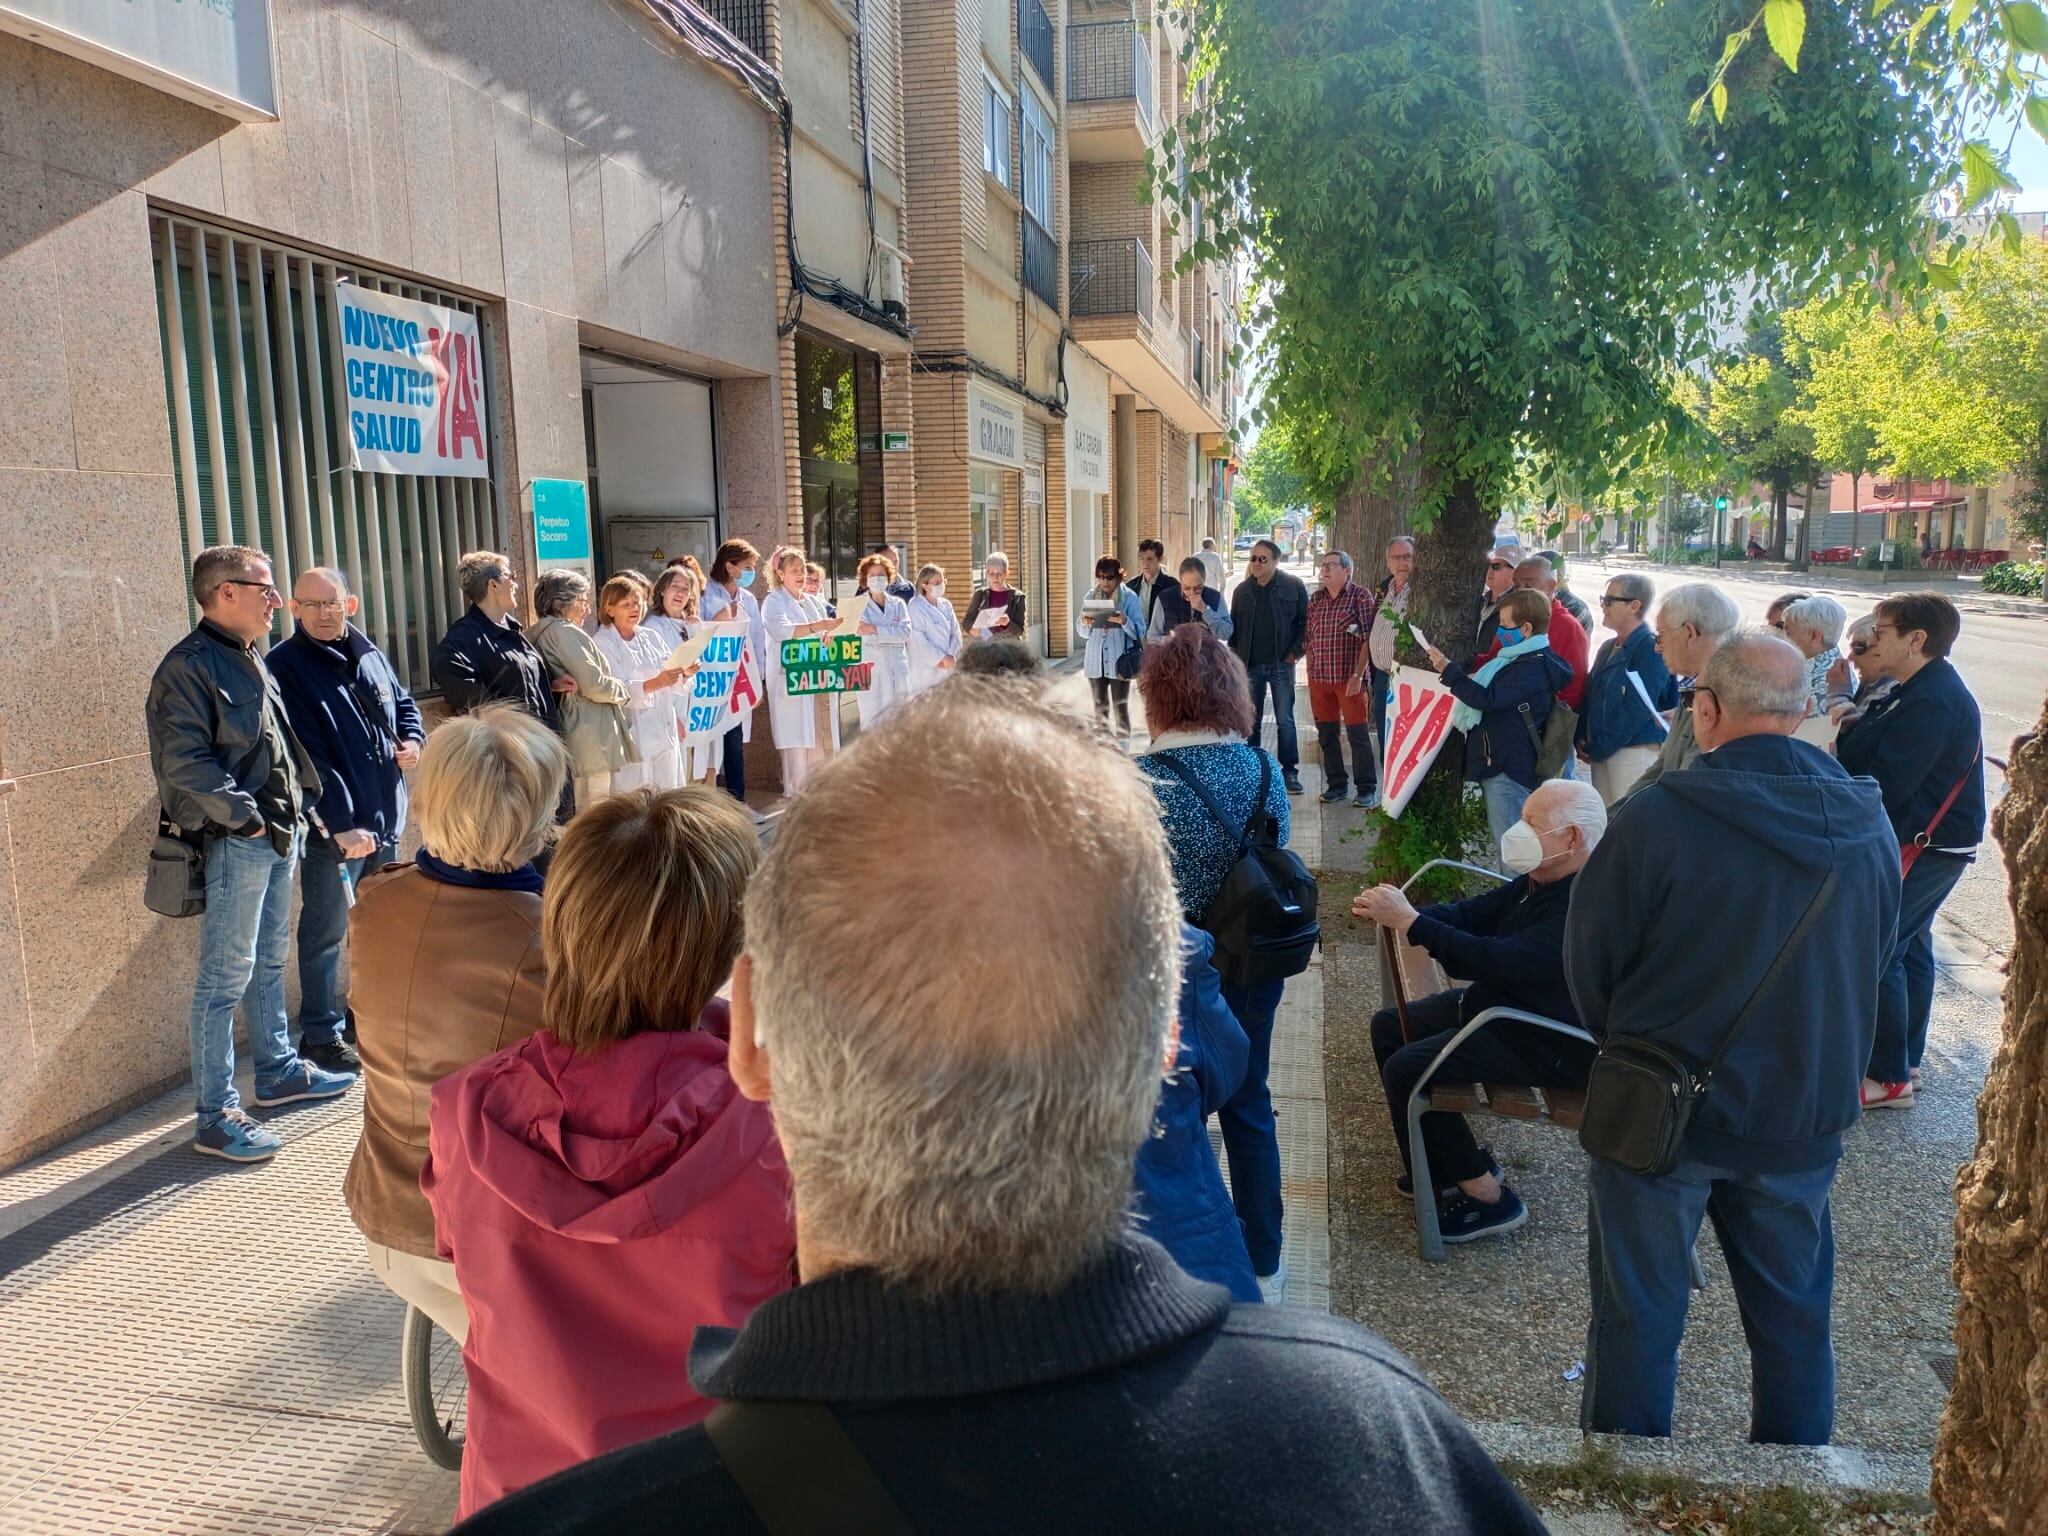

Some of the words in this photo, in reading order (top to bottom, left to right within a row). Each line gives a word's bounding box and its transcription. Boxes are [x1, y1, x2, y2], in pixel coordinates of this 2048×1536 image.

[344, 306, 420, 357] NUEVO
[347, 359, 434, 407] CENTRO
[428, 327, 484, 460] YA!
[351, 410, 421, 454] SALUD
[540, 515, 570, 529] Perpetuo
[541, 530, 568, 542] Socorro
[700, 636, 745, 663] UEV
[781, 641, 838, 665] CENTRO
[842, 641, 860, 660] DE
[694, 671, 736, 698] CENT
[789, 669, 836, 692] SALUD
